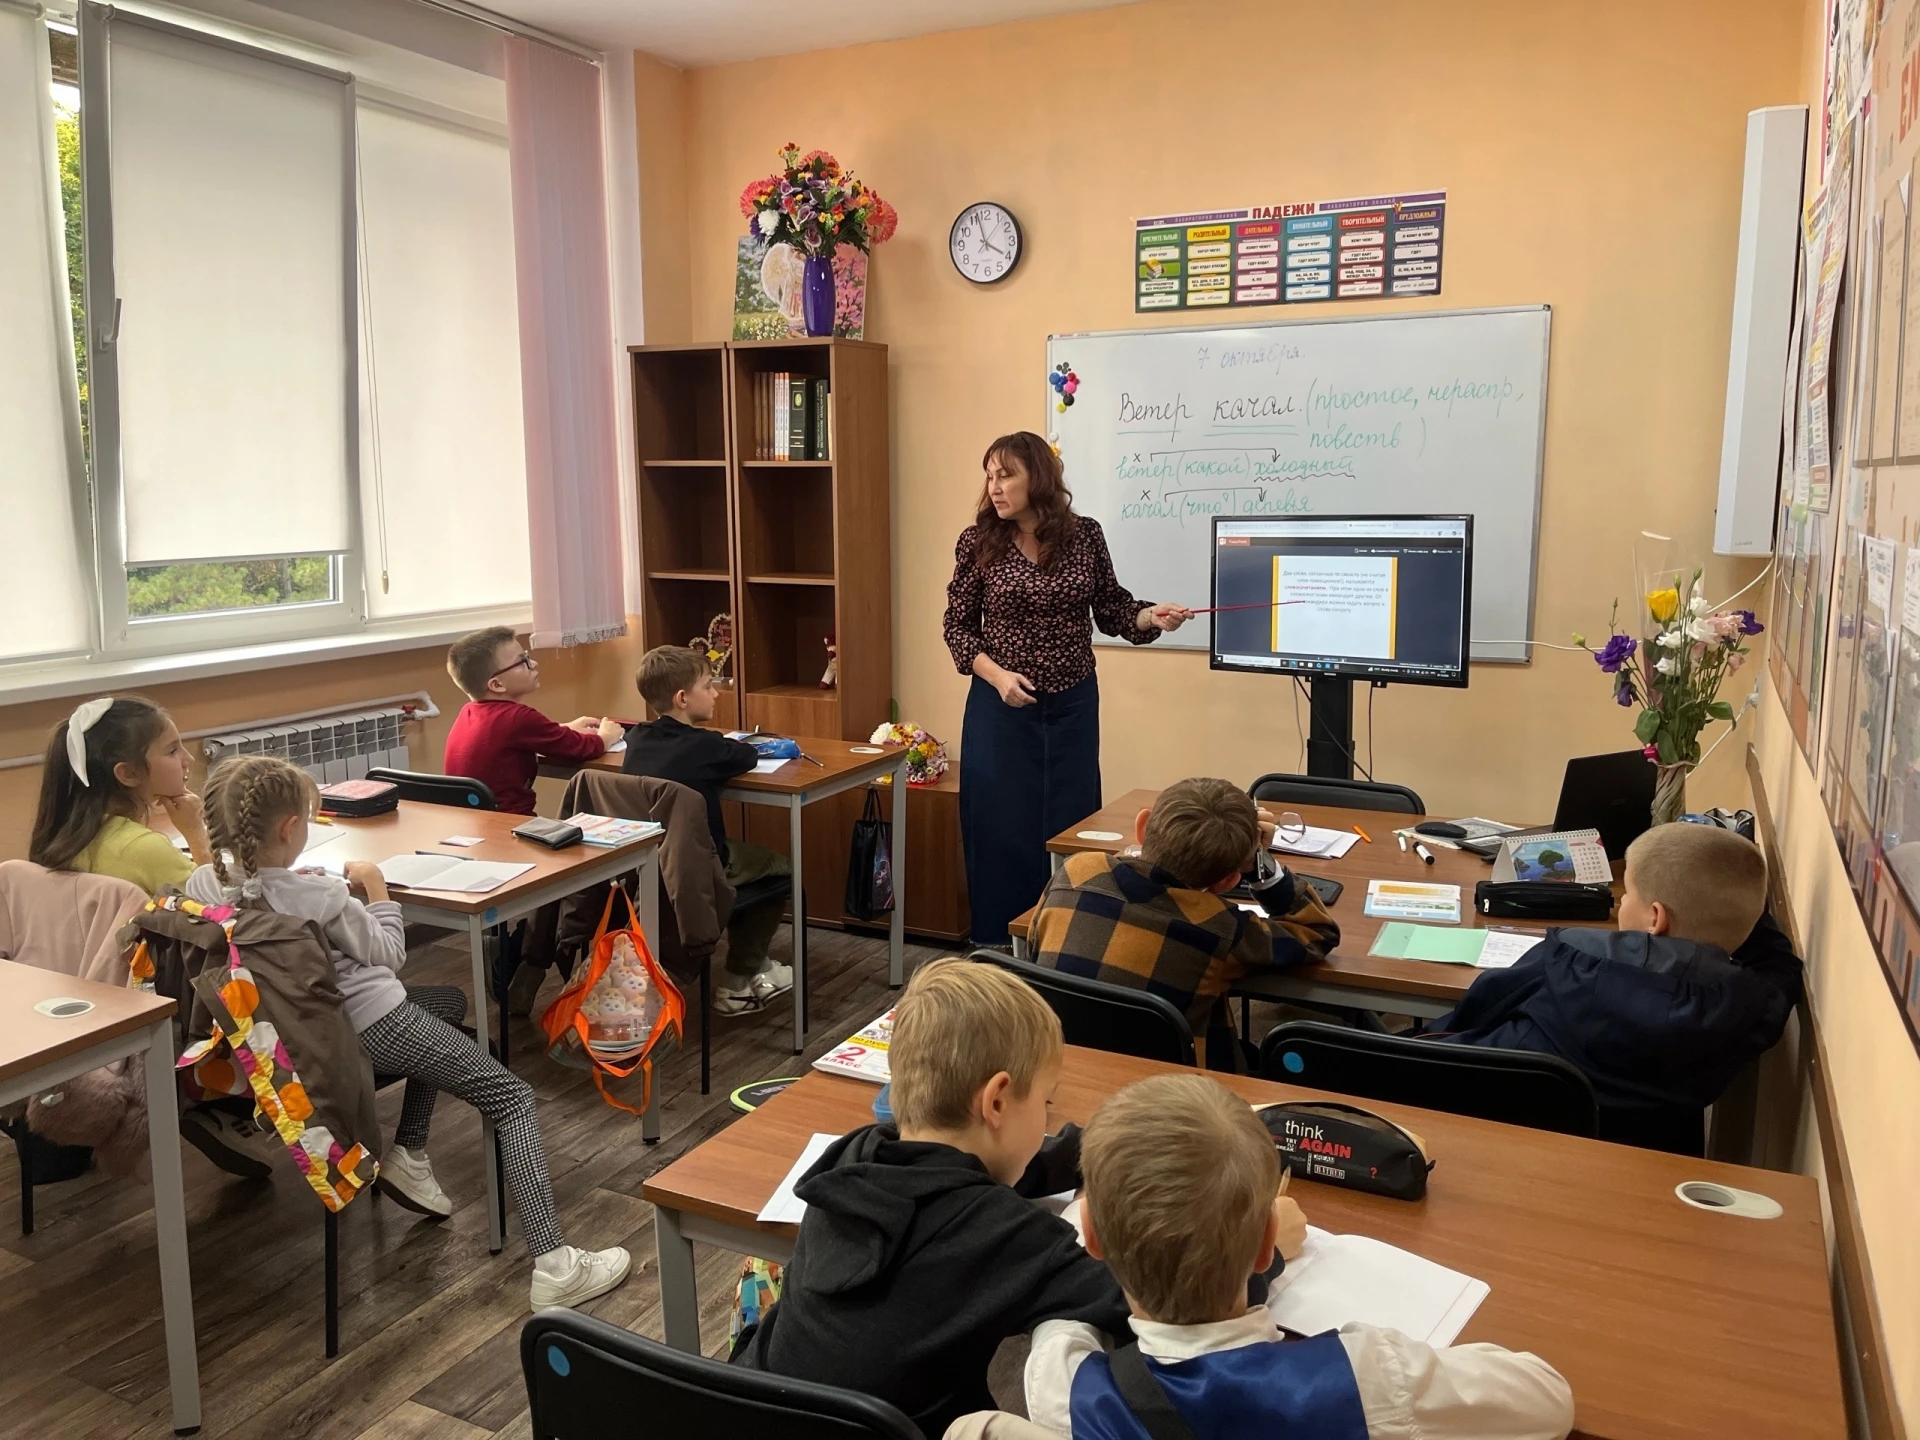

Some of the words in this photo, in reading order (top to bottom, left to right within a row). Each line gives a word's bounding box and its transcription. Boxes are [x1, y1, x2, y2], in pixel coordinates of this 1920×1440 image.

[981, 210, 991, 220] 12
[1252, 203, 1315, 219] ПАДЕЖИ
[1399, 210, 1436, 220] ПРЕДЛОЖНЫЙ
[1342, 215, 1384, 226] ТВОРИТЕЛЬНЫЙ
[962, 227, 970, 237] 10
[1004, 222, 1011, 232] 2
[1244, 225, 1273, 234] ДАТЕЛЬНЫЙ
[1142, 233, 1178, 243] ИМЕНИТЕЛЬНЫЙ
[1193, 228, 1226, 238] РОДИТЕЛЬНЫЙ
[958, 240, 965, 251] 9
[1008, 236, 1016, 246] 3
[963, 254, 970, 264] 8
[1005, 251, 1012, 261] 4
[972, 264, 979, 274] 7
[984, 266, 992, 276] 6
[997, 262, 1004, 272] 5
[1198, 347, 1210, 369] 7
[1119, 393, 1195, 442] Ветер
[1214, 396, 1302, 421] качал.
[1306, 378, 1418, 429] (простое,
[1116, 455, 1172, 498] ветер
[1176, 452, 1250, 486] (какой)
[1254, 455, 1354, 483] холодный
[1121, 500, 1178, 520] качал
[835, 1046, 866, 1062] 2
[822, 1057, 862, 1068] КЛАСС
[1285, 1120, 1324, 1140] think
[1300, 1138, 1351, 1159] AGAIN
